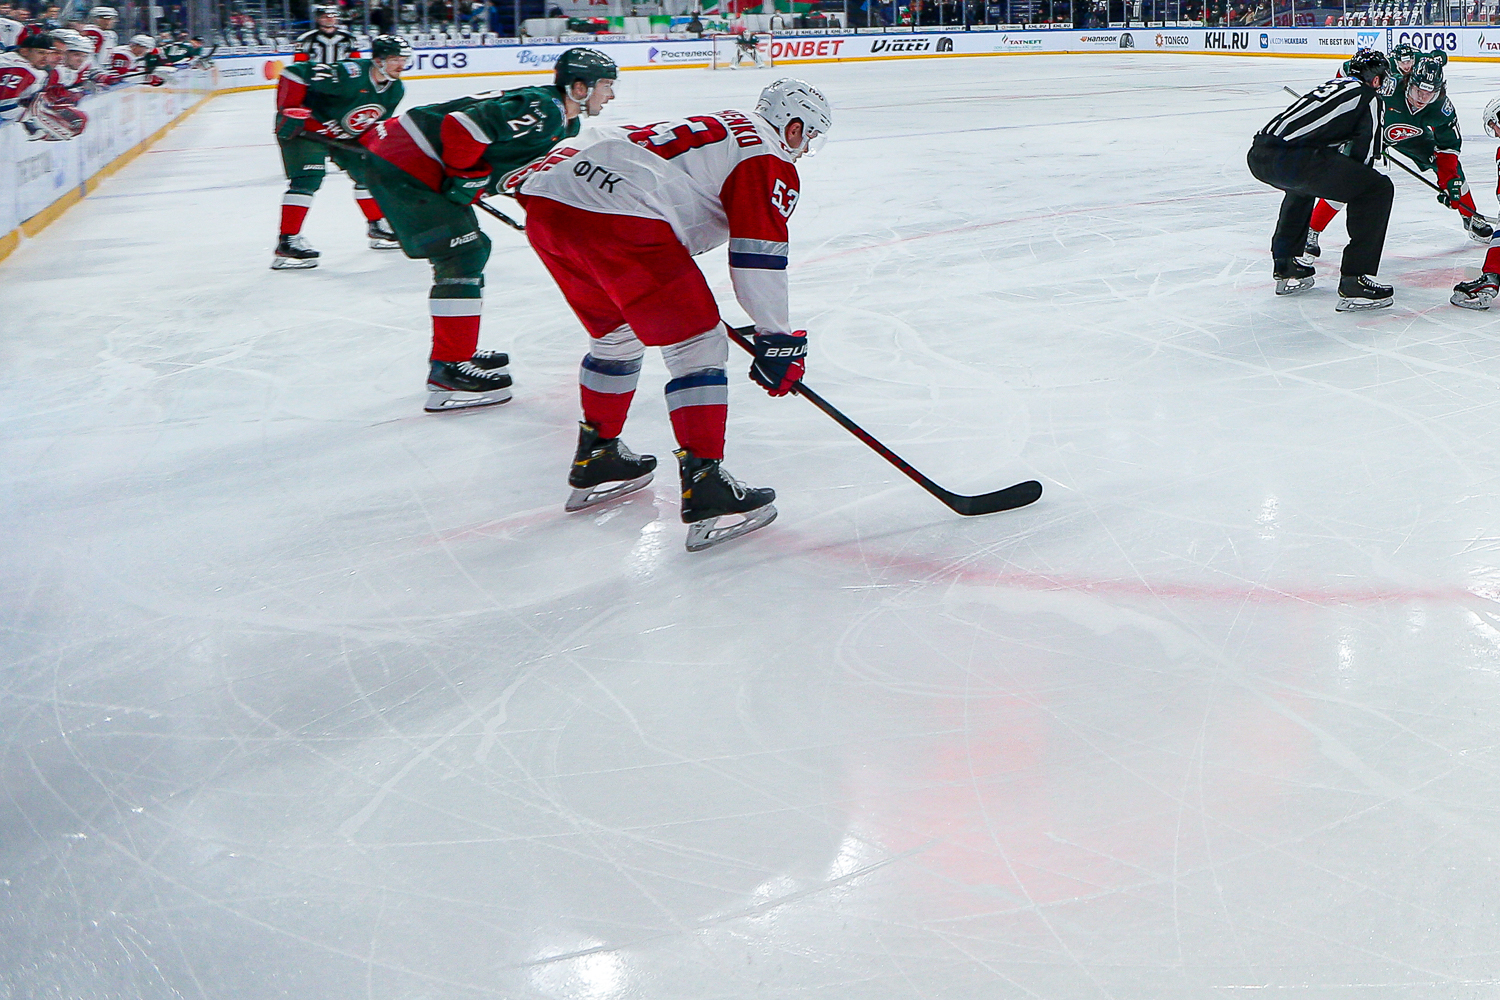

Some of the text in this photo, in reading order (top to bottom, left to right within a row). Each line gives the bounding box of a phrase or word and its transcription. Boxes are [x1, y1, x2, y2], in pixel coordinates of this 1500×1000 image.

[1204, 32, 1249, 50] KHL.RU
[1319, 38, 1355, 46] THE BEST RUN
[1358, 34, 1374, 49] SAP
[572, 160, 624, 194] ФГК
[771, 178, 800, 217] 53
